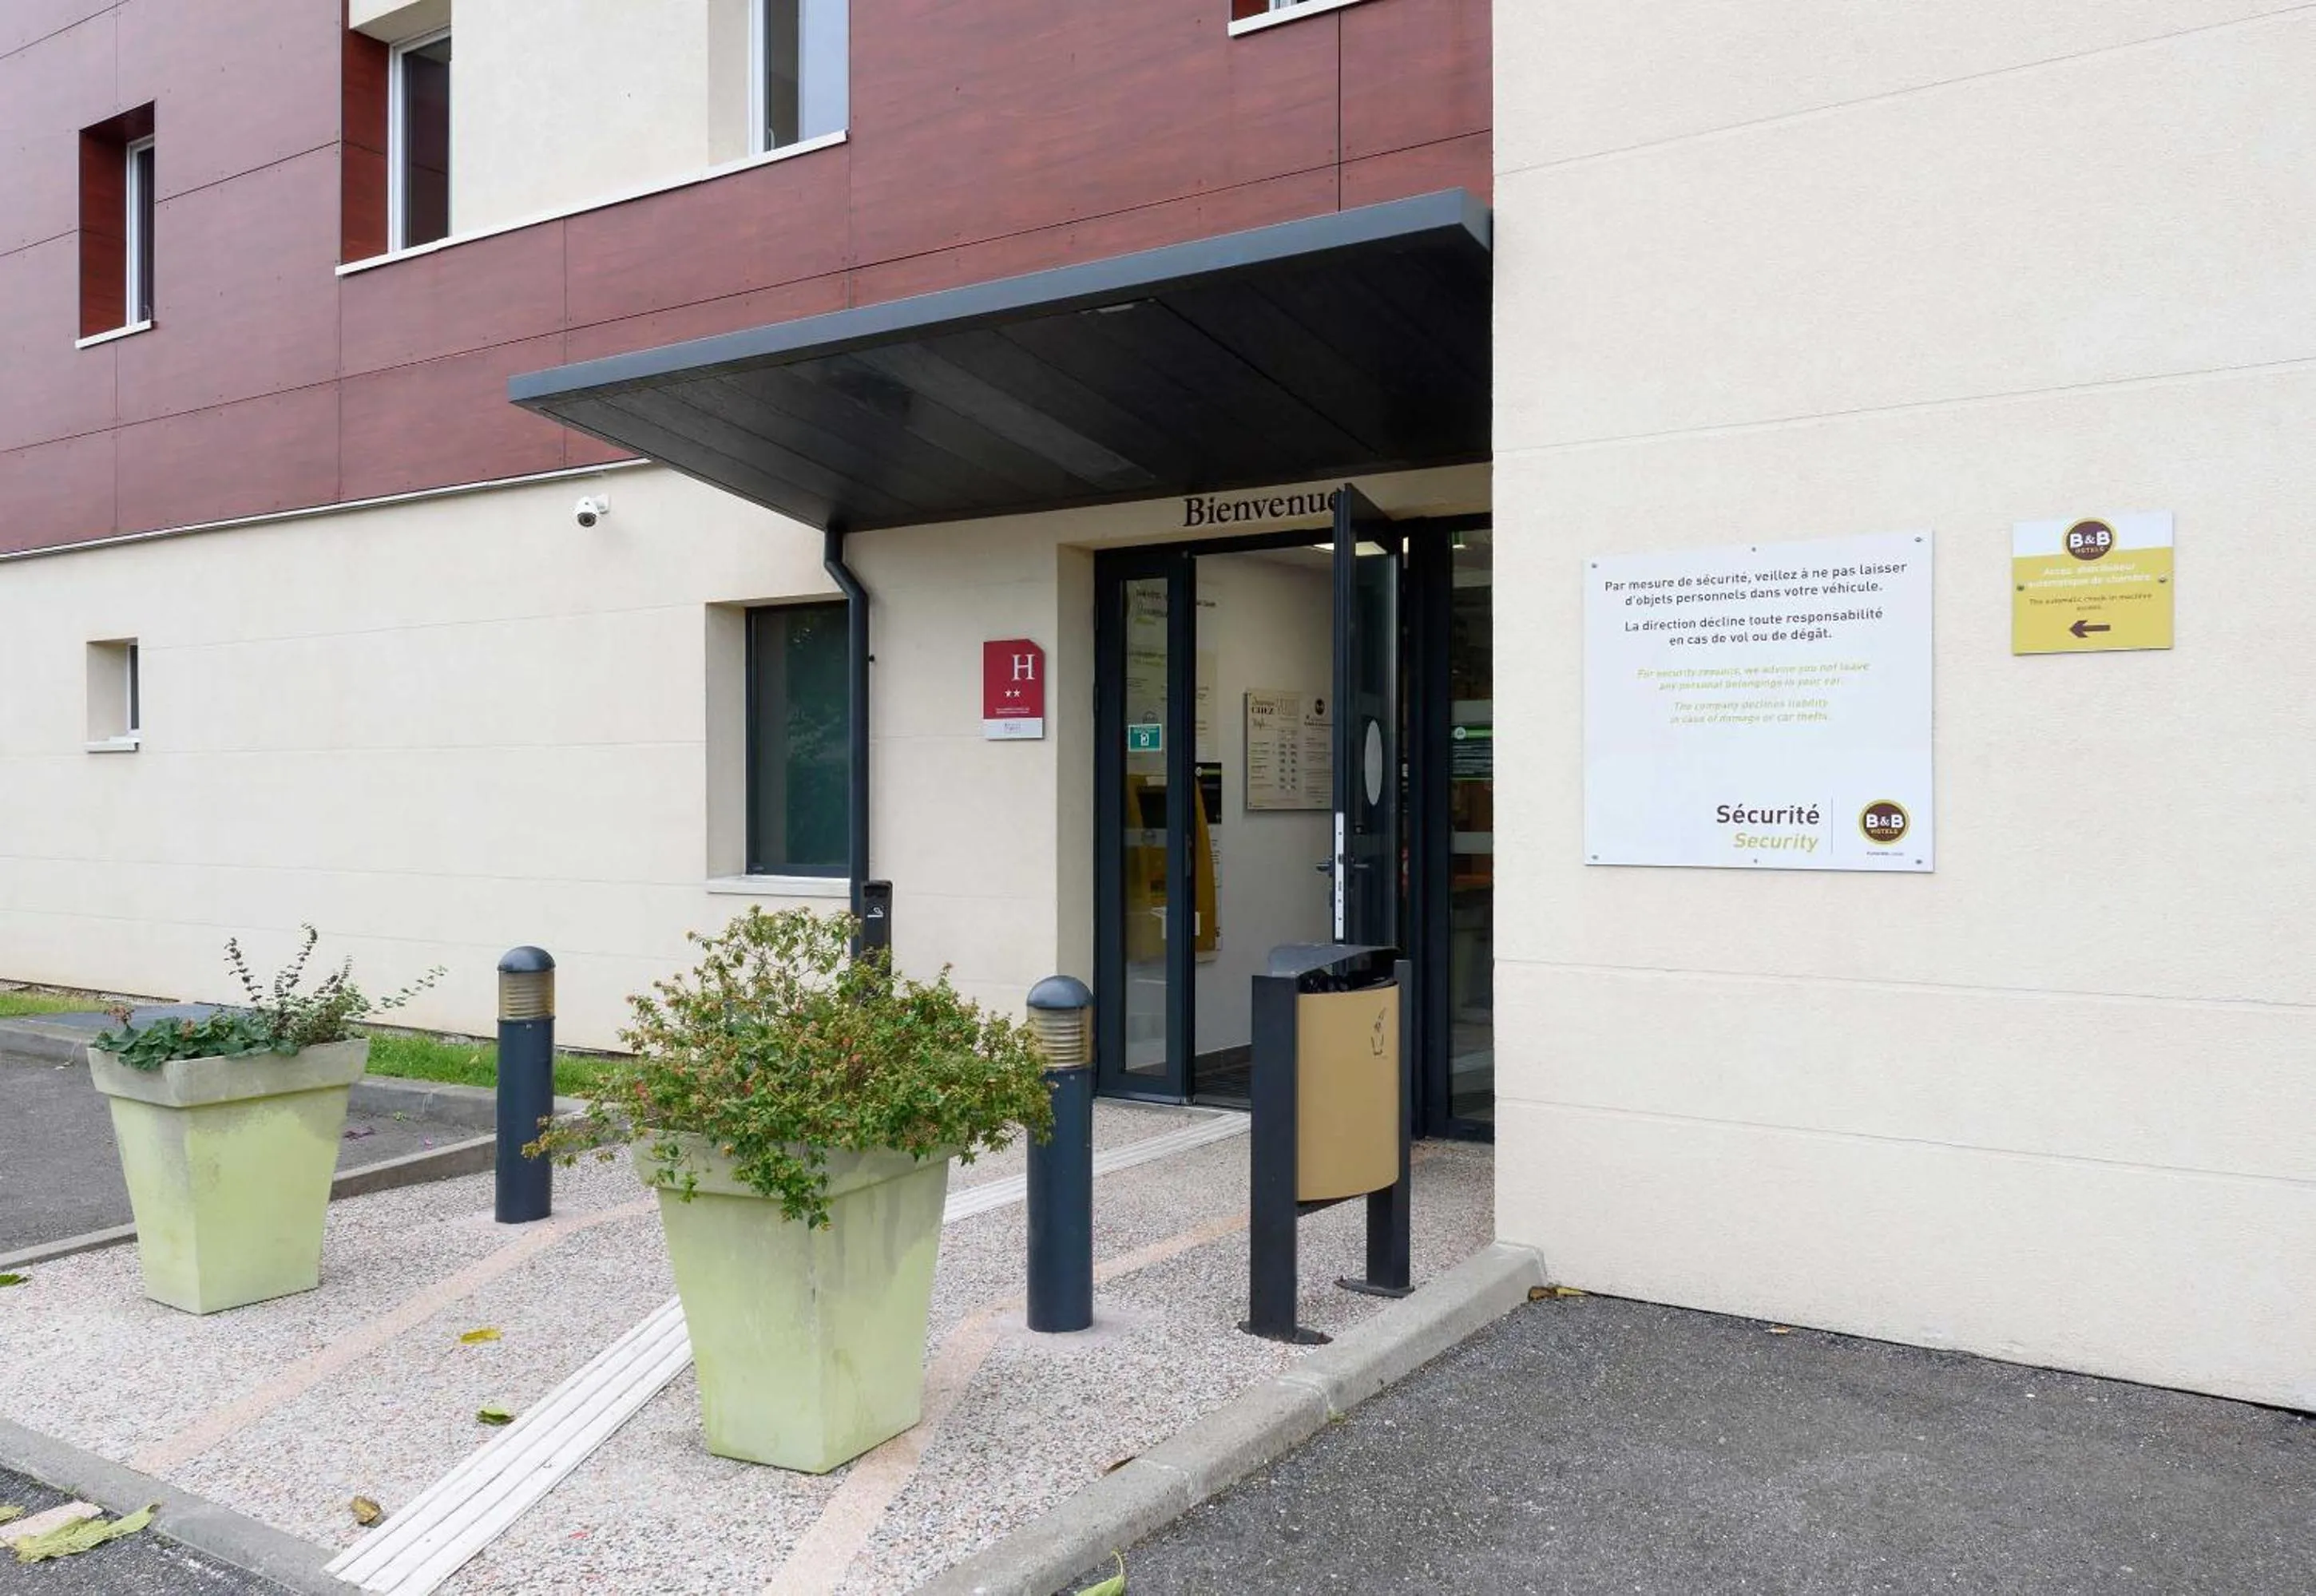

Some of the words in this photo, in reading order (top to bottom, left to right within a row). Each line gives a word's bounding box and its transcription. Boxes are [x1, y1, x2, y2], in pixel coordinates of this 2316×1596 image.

[2069, 531, 2111, 549] B&B
[1604, 580, 1626, 592] Par
[1628, 579, 1675, 590] mesure
[1677, 576, 1693, 587] de
[1695, 572, 1752, 585] sécurité,
[1755, 569, 1798, 581] veillez
[1811, 568, 1829, 578] ne
[1832, 567, 1856, 580] pas
[1859, 563, 1908, 575] laisser
[1624, 594, 1673, 607] d'objets
[1676, 589, 1747, 605] personnels
[1750, 588, 1781, 599] dans
[1783, 585, 1818, 596] votre
[1822, 580, 1883, 594] véhicule.
[1624, 621, 1640, 632] La
[1642, 618, 1696, 631] direction
[1699, 616, 1746, 628] décline
[1749, 614, 1783, 625] toute
[1786, 607, 1883, 624] responsabilité
[1668, 636, 1684, 646] en
[1687, 636, 1708, 644] cas
[1711, 633, 1727, 644] de
[1730, 632, 1749, 643] vol
[1751, 632, 1767, 642] ou
[1771, 630, 1787, 640] de
[1791, 628, 1832, 641] dégât.
[1011, 653, 1036, 681] H
[1716, 803, 1820, 825] Sécurité
[1866, 813, 1905, 829] B&B
[1733, 832, 1818, 853] Security
